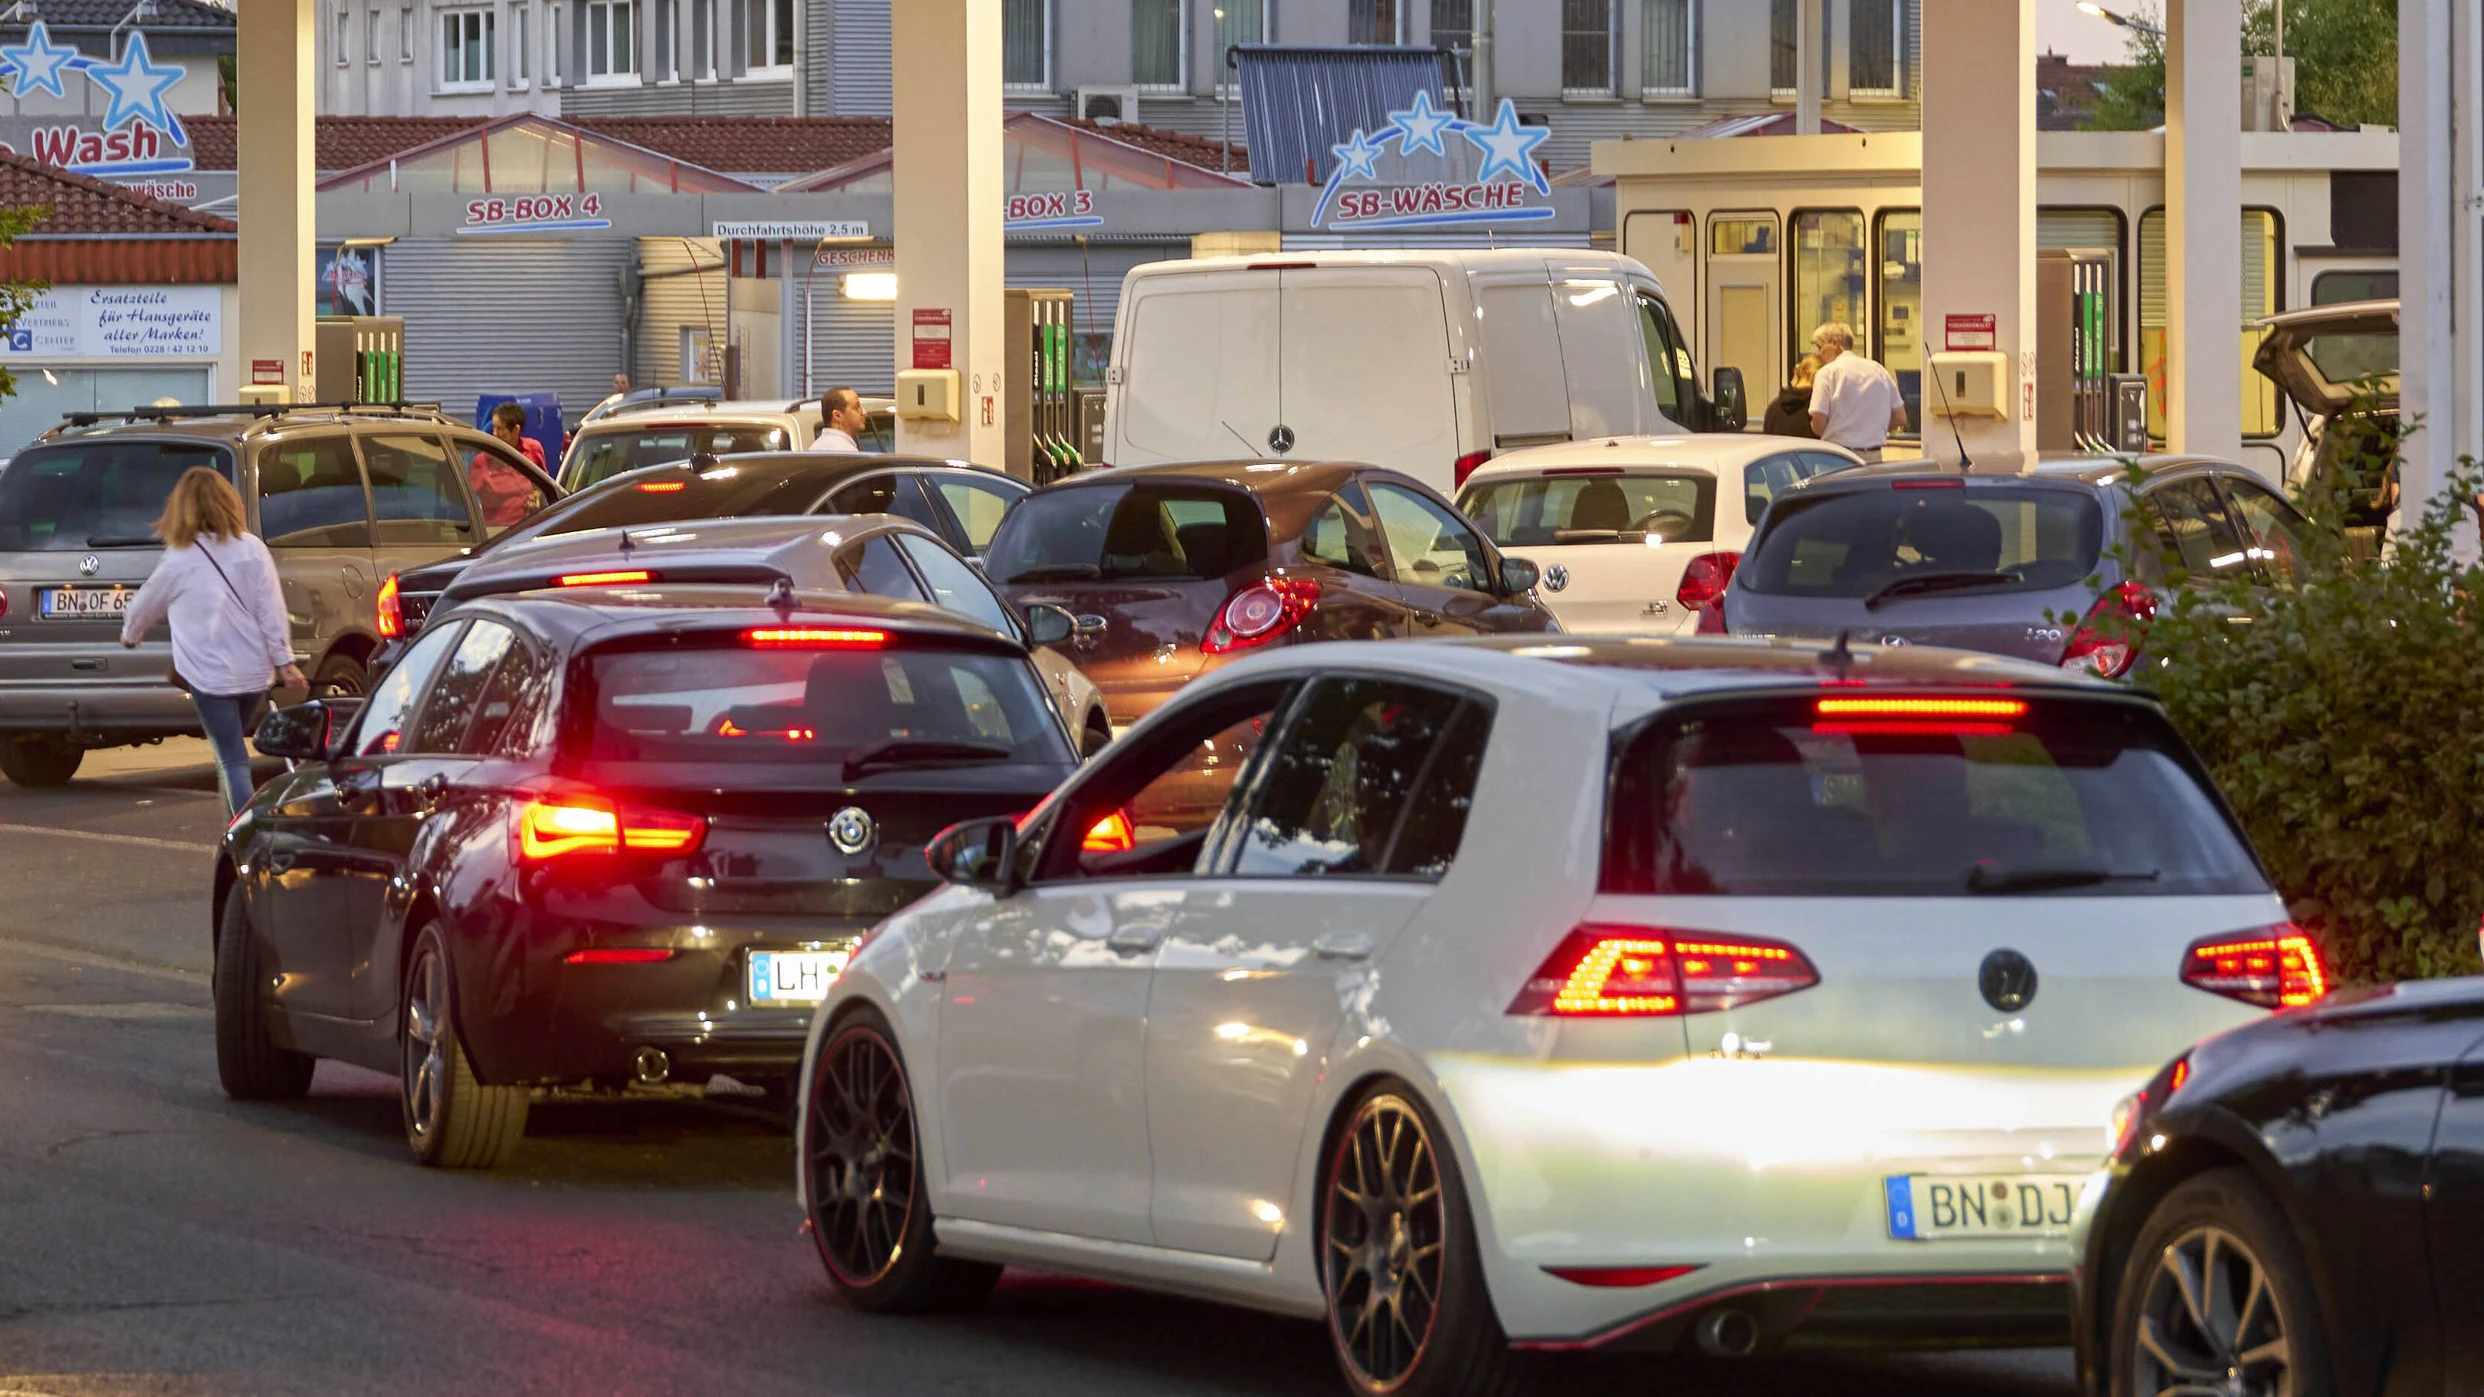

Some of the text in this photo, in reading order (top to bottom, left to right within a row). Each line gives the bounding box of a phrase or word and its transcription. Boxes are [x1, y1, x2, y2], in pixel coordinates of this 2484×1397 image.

[34, 121, 158, 166] Wash
[467, 194, 600, 222] SB-BOX 4
[1074, 191, 1091, 214] 3
[1339, 182, 1523, 218] SB-WÄSCHE
[717, 223, 864, 237] Durchfahrtshöhe 2,5 m
[90, 289, 168, 304] Ersatzteile
[99, 308, 211, 328] für Hausgeräte
[104, 326, 204, 343] aller Marken!
[110, 345, 141, 354] Telefon
[144, 345, 165, 353] 0228
[172, 345, 183, 353] 42
[186, 345, 196, 353] 12
[199, 345, 209, 353] 10
[57, 593, 78, 611] BN
[89, 592, 110, 610] OF
[777, 961, 818, 990] LH
[1930, 1183, 2073, 1227] BN DJ
